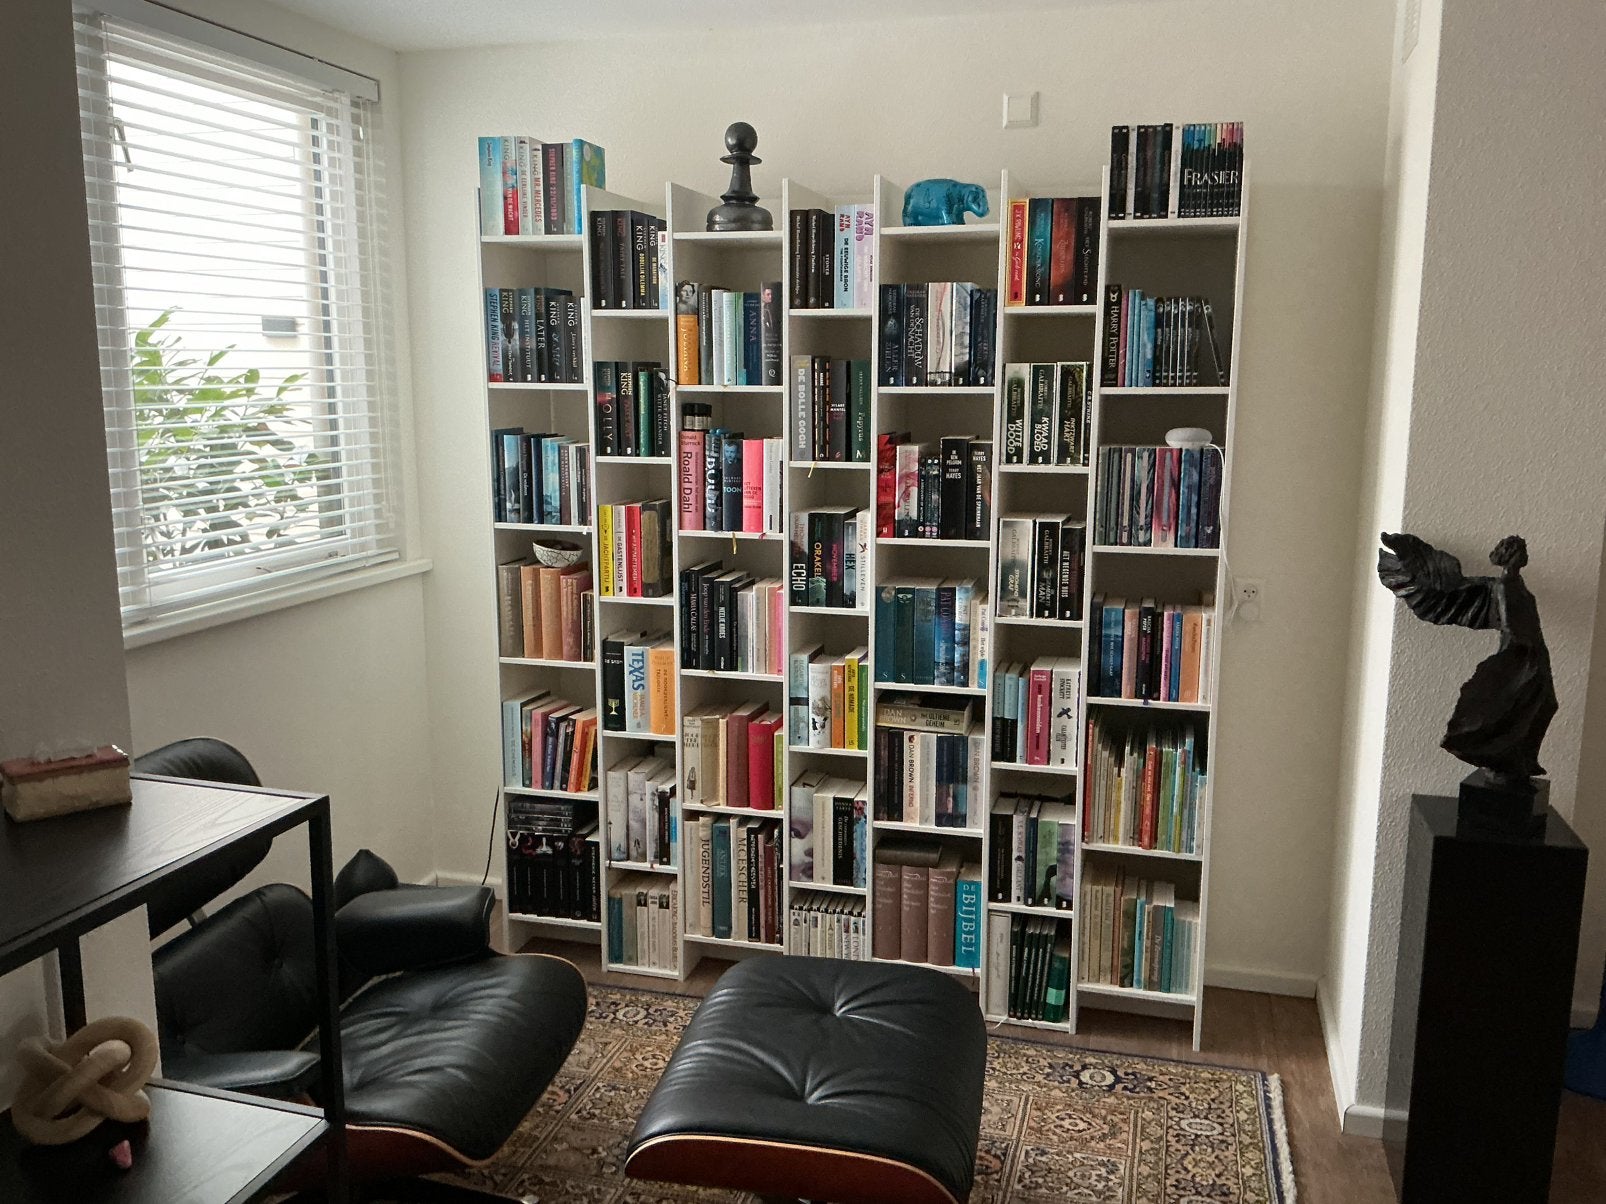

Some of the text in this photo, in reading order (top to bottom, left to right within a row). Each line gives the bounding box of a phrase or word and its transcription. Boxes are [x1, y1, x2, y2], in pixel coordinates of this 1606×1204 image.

[504, 139, 512, 160] KING
[1183, 168, 1239, 186] FRASIER
[534, 191, 542, 223] MERCEDES
[636, 225, 644, 250] KING
[855, 211, 865, 242] RAND
[864, 212, 875, 236] AYN
[501, 292, 509, 314] KING
[549, 301, 557, 326] KING
[567, 302, 575, 327] KING
[490, 294, 501, 367] STEPHEN KING REVIVAL
[536, 320, 546, 350] LATER
[749, 311, 757, 342] ANNA
[1108, 305, 1120, 368] HARRY POTTER
[891, 343, 899, 372] ALLER
[907, 327, 915, 359] NACHT
[914, 318, 924, 369] SCHADUW
[620, 372, 628, 396] KING
[798, 368, 806, 449] DE BOLLE GOGH
[857, 412, 866, 441] Papyrus
[1007, 423, 1016, 454] DOOD
[1014, 419, 1023, 448] WITTE
[1033, 423, 1042, 452] BLOED
[1041, 417, 1050, 450] KWAAD
[1063, 420, 1071, 442] HART
[682, 451, 693, 513] Roald Dahl
[814, 542, 822, 578] ORAKEL
[845, 553, 856, 570] HEX
[1061, 562, 1070, 584] NEGENDE
[702, 583, 710, 596] Joop
[791, 563, 807, 591] ECHO
[940, 592, 952, 605] PAT
[1038, 582, 1046, 603] MAN
[690, 593, 698, 631] MARIA CALLAS
[629, 651, 645, 691] TEXAS
[883, 707, 903, 717] DAN
[925, 719, 945, 728] GEHEIM
[973, 758, 981, 783] BROWN
[701, 839, 710, 907] JUGENDSTIL
[738, 858, 747, 904] ESCHER
[958, 894, 976, 954] BIJBEL
